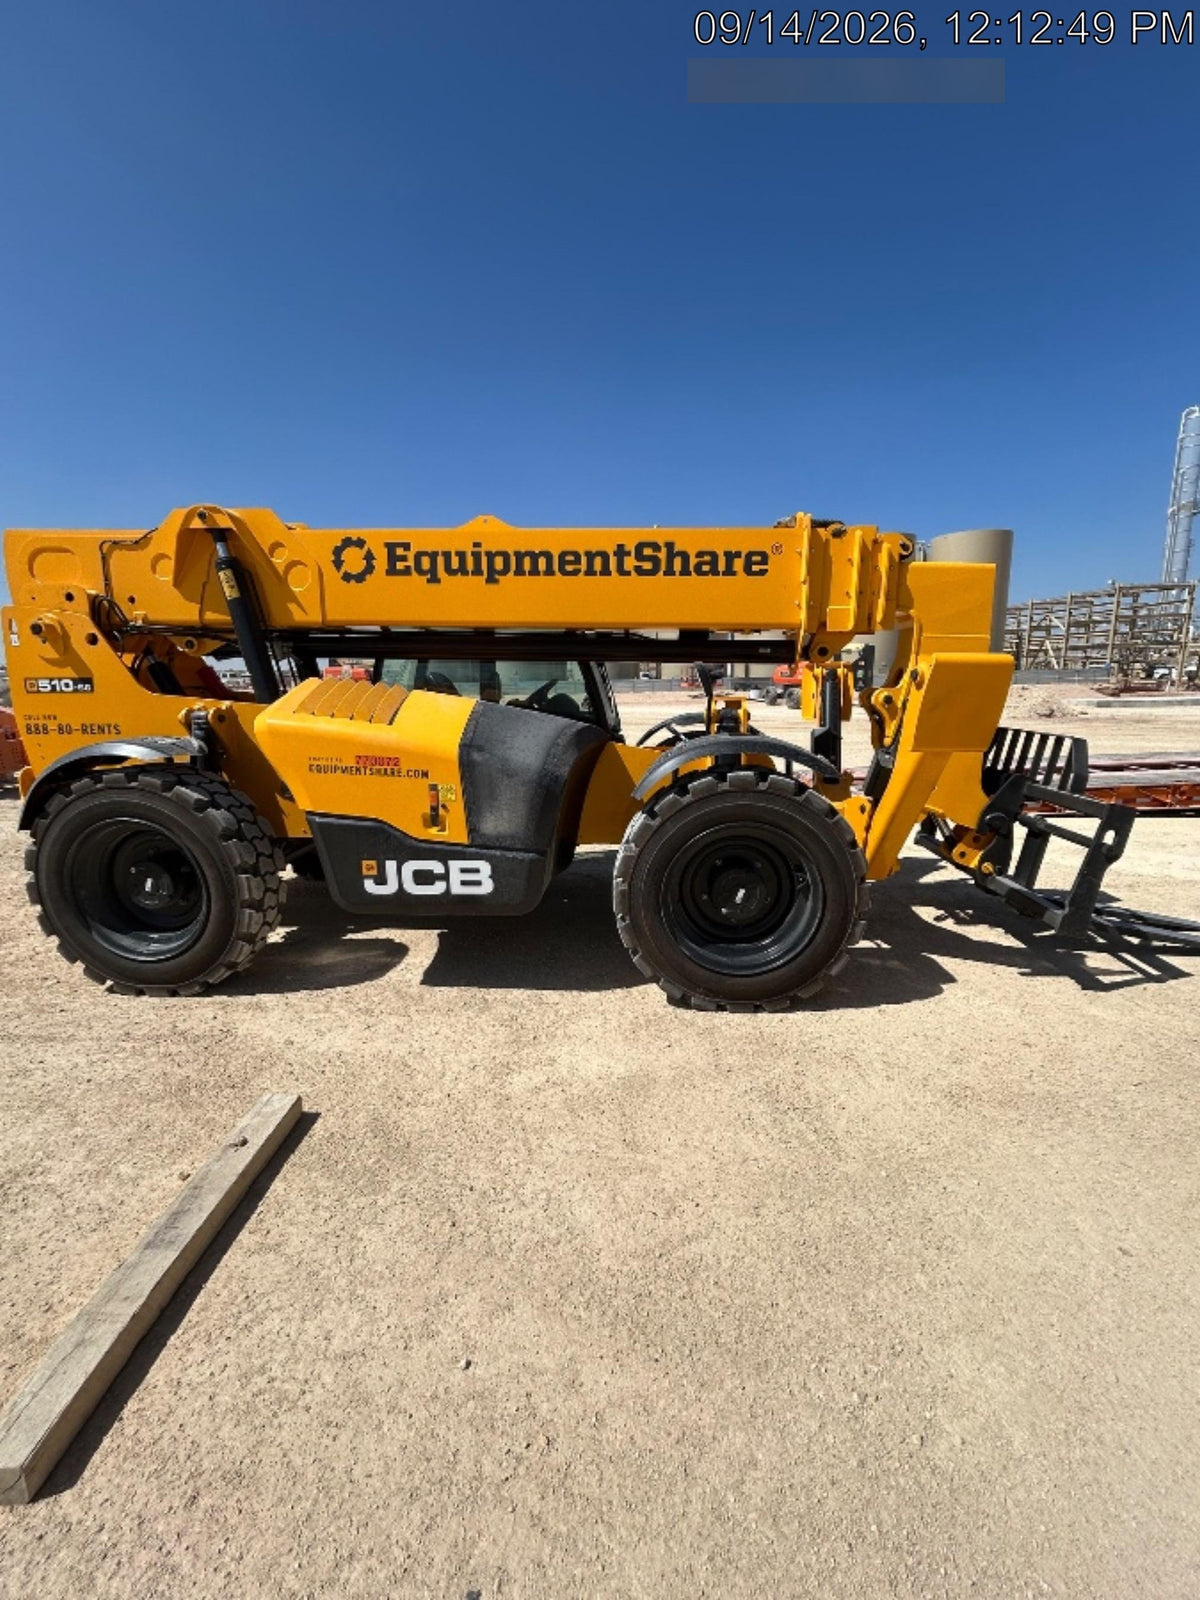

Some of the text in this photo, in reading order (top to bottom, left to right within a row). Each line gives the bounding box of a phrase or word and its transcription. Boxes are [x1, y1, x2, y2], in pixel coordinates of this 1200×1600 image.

[384, 541, 770, 584] EquipmentShare
[25, 723, 122, 735] 888-80-RENTS
[308, 763, 430, 779] EQUIPMENTSHARE.COM
[363, 859, 494, 895] JCB
